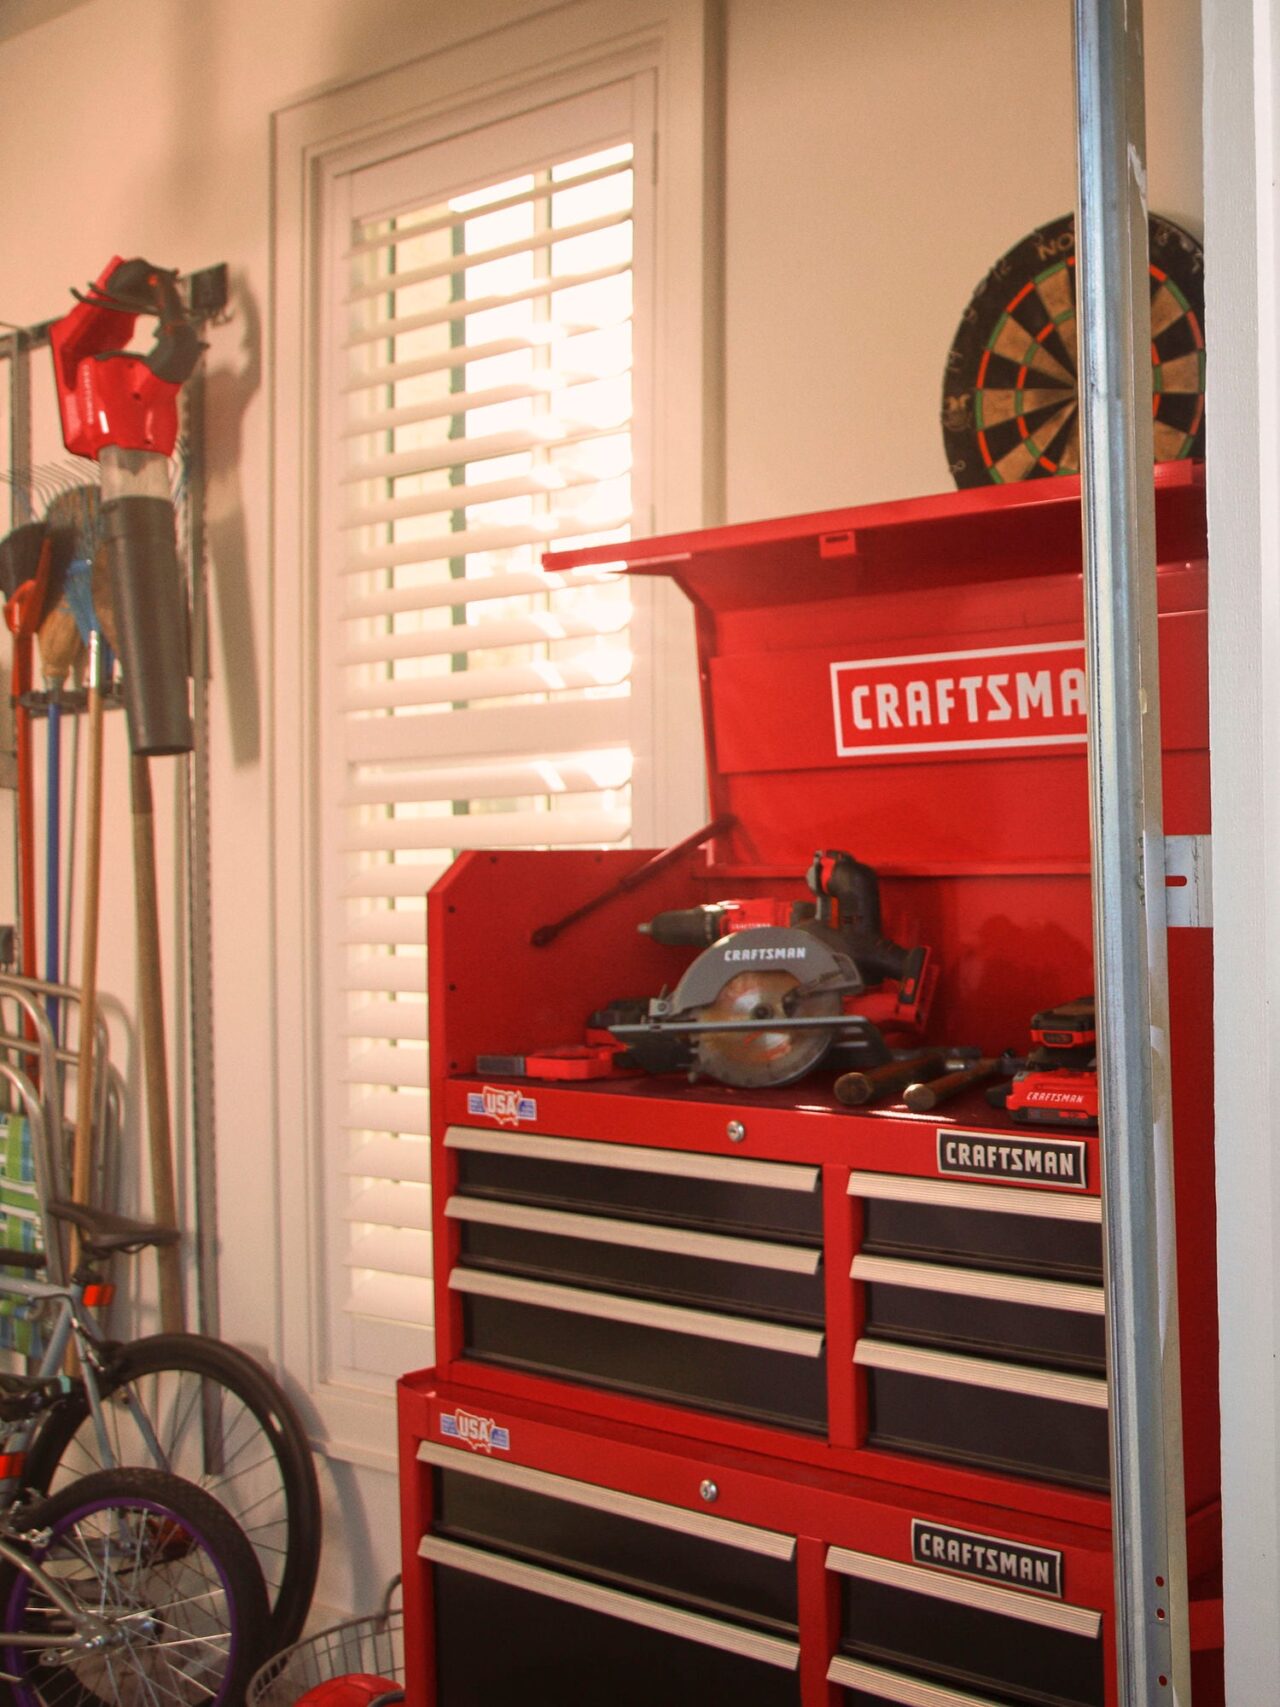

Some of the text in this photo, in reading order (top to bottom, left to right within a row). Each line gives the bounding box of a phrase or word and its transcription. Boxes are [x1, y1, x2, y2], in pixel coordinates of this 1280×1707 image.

[851, 668, 1087, 729] CRAFTSMA
[724, 946, 807, 962] CRAFTSMAN
[487, 1093, 518, 1116] USA
[1026, 1091, 1084, 1104] CRAFTSMAN
[945, 1142, 1074, 1177] CRAFTSMAN
[459, 1415, 489, 1443] USA
[920, 1532, 1050, 1585] CRAFTSMAN
